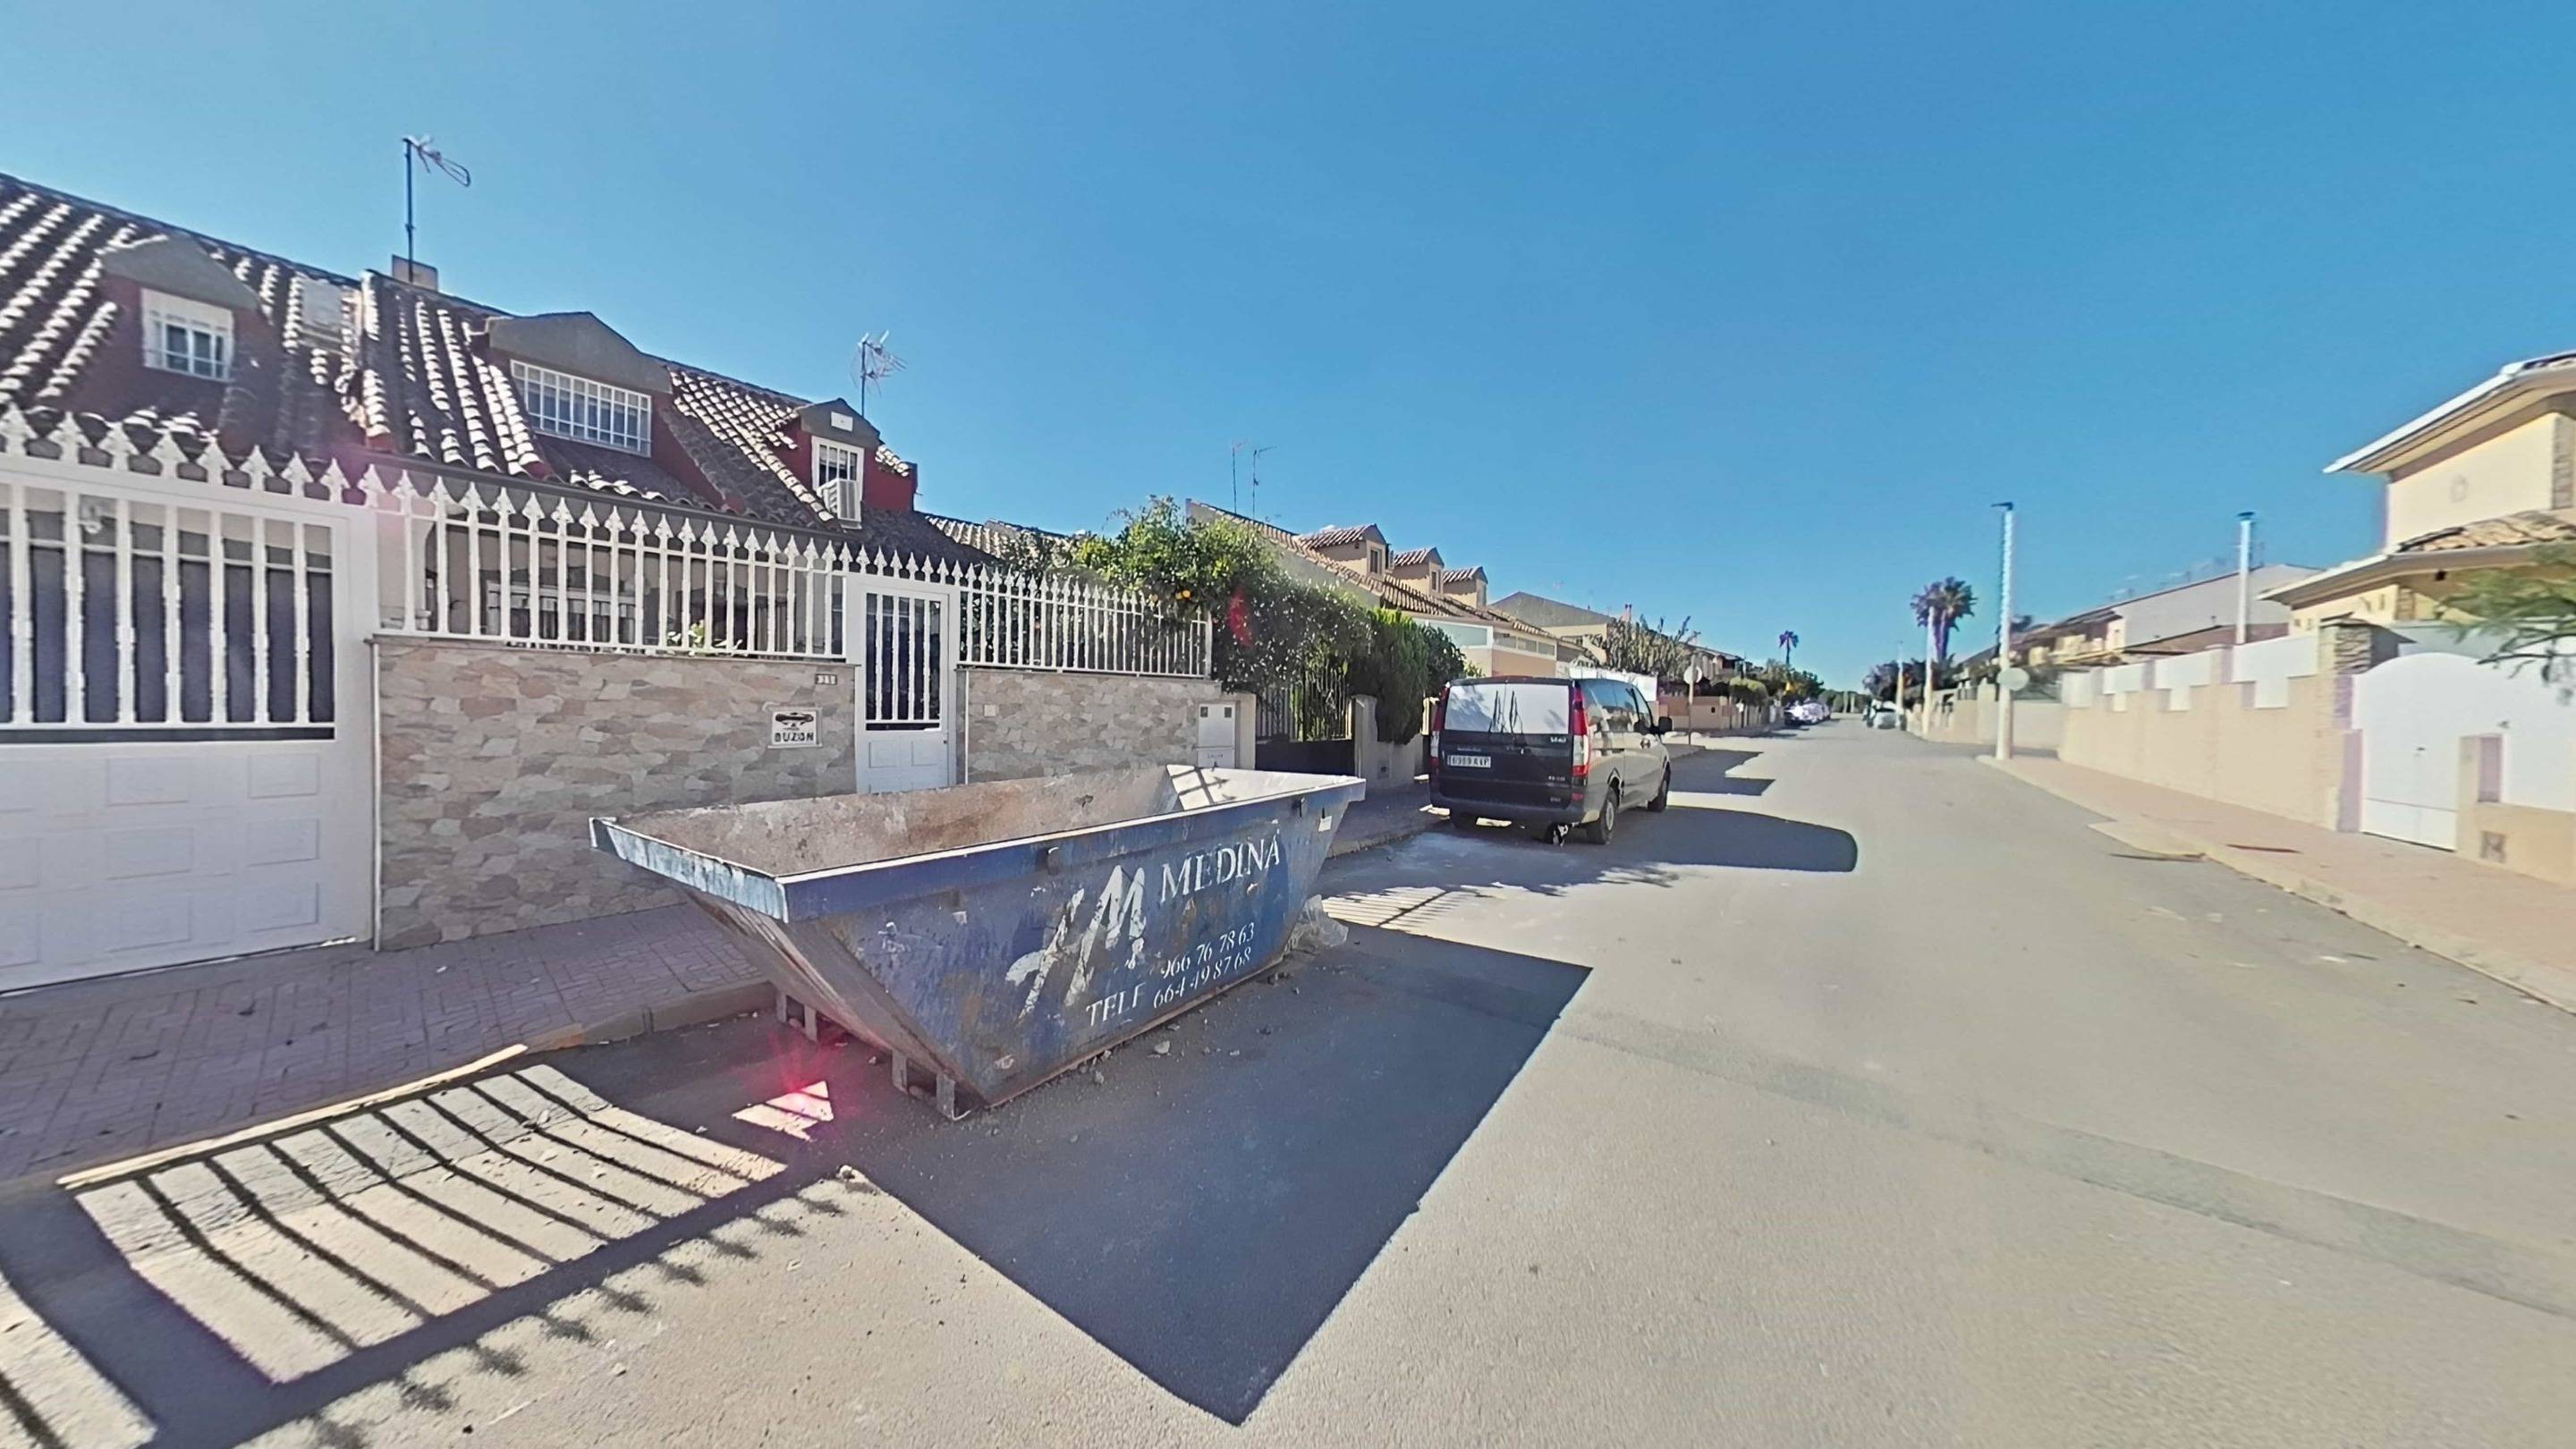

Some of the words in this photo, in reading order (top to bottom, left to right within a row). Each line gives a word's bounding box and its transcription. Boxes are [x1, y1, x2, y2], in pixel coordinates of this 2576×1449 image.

[1160, 834, 1280, 903] MEDINA
[1197, 941, 1213, 965] 76
[1219, 930, 1236, 953] 78
[1239, 922, 1254, 945] 63
[1154, 976, 1186, 1009] 664
[1213, 954, 1232, 980] 87
[1233, 946, 1251, 970] 68
